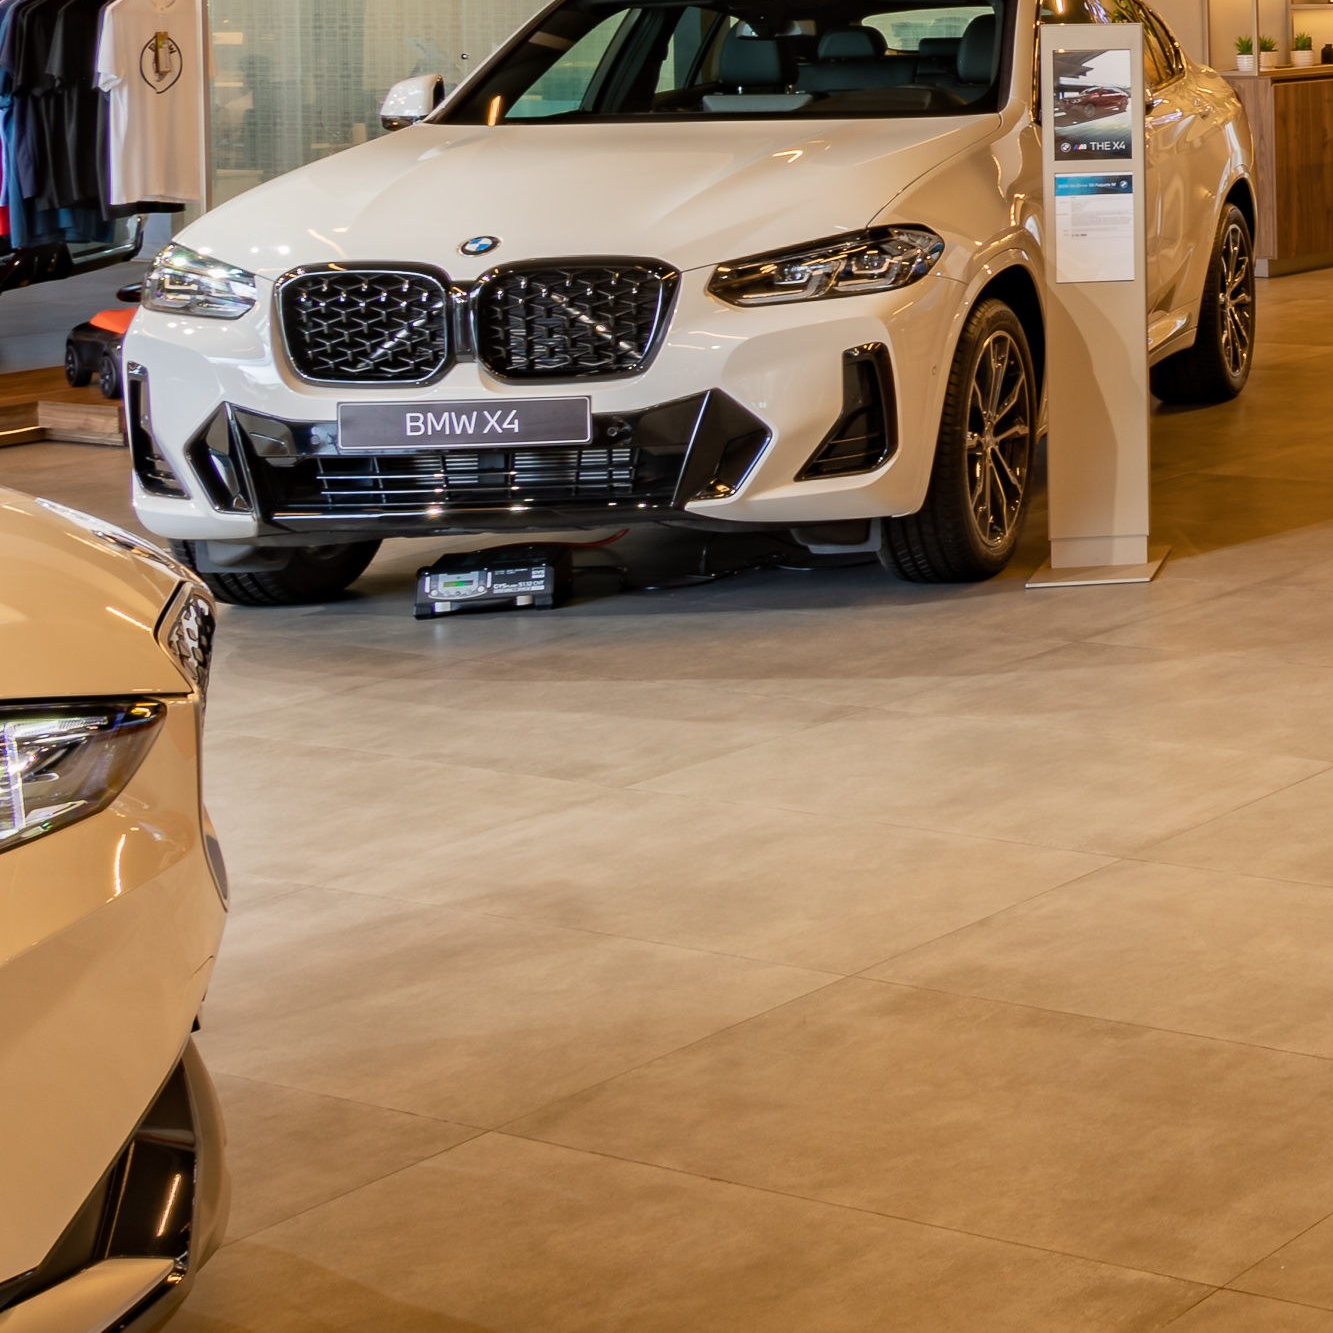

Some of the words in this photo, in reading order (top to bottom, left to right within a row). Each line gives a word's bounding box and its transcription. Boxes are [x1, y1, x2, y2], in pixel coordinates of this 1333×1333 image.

[1089, 141, 1111, 151] THE
[1112, 140, 1126, 150] X4
[405, 410, 478, 436] BMW
[482, 409, 519, 434] X4
